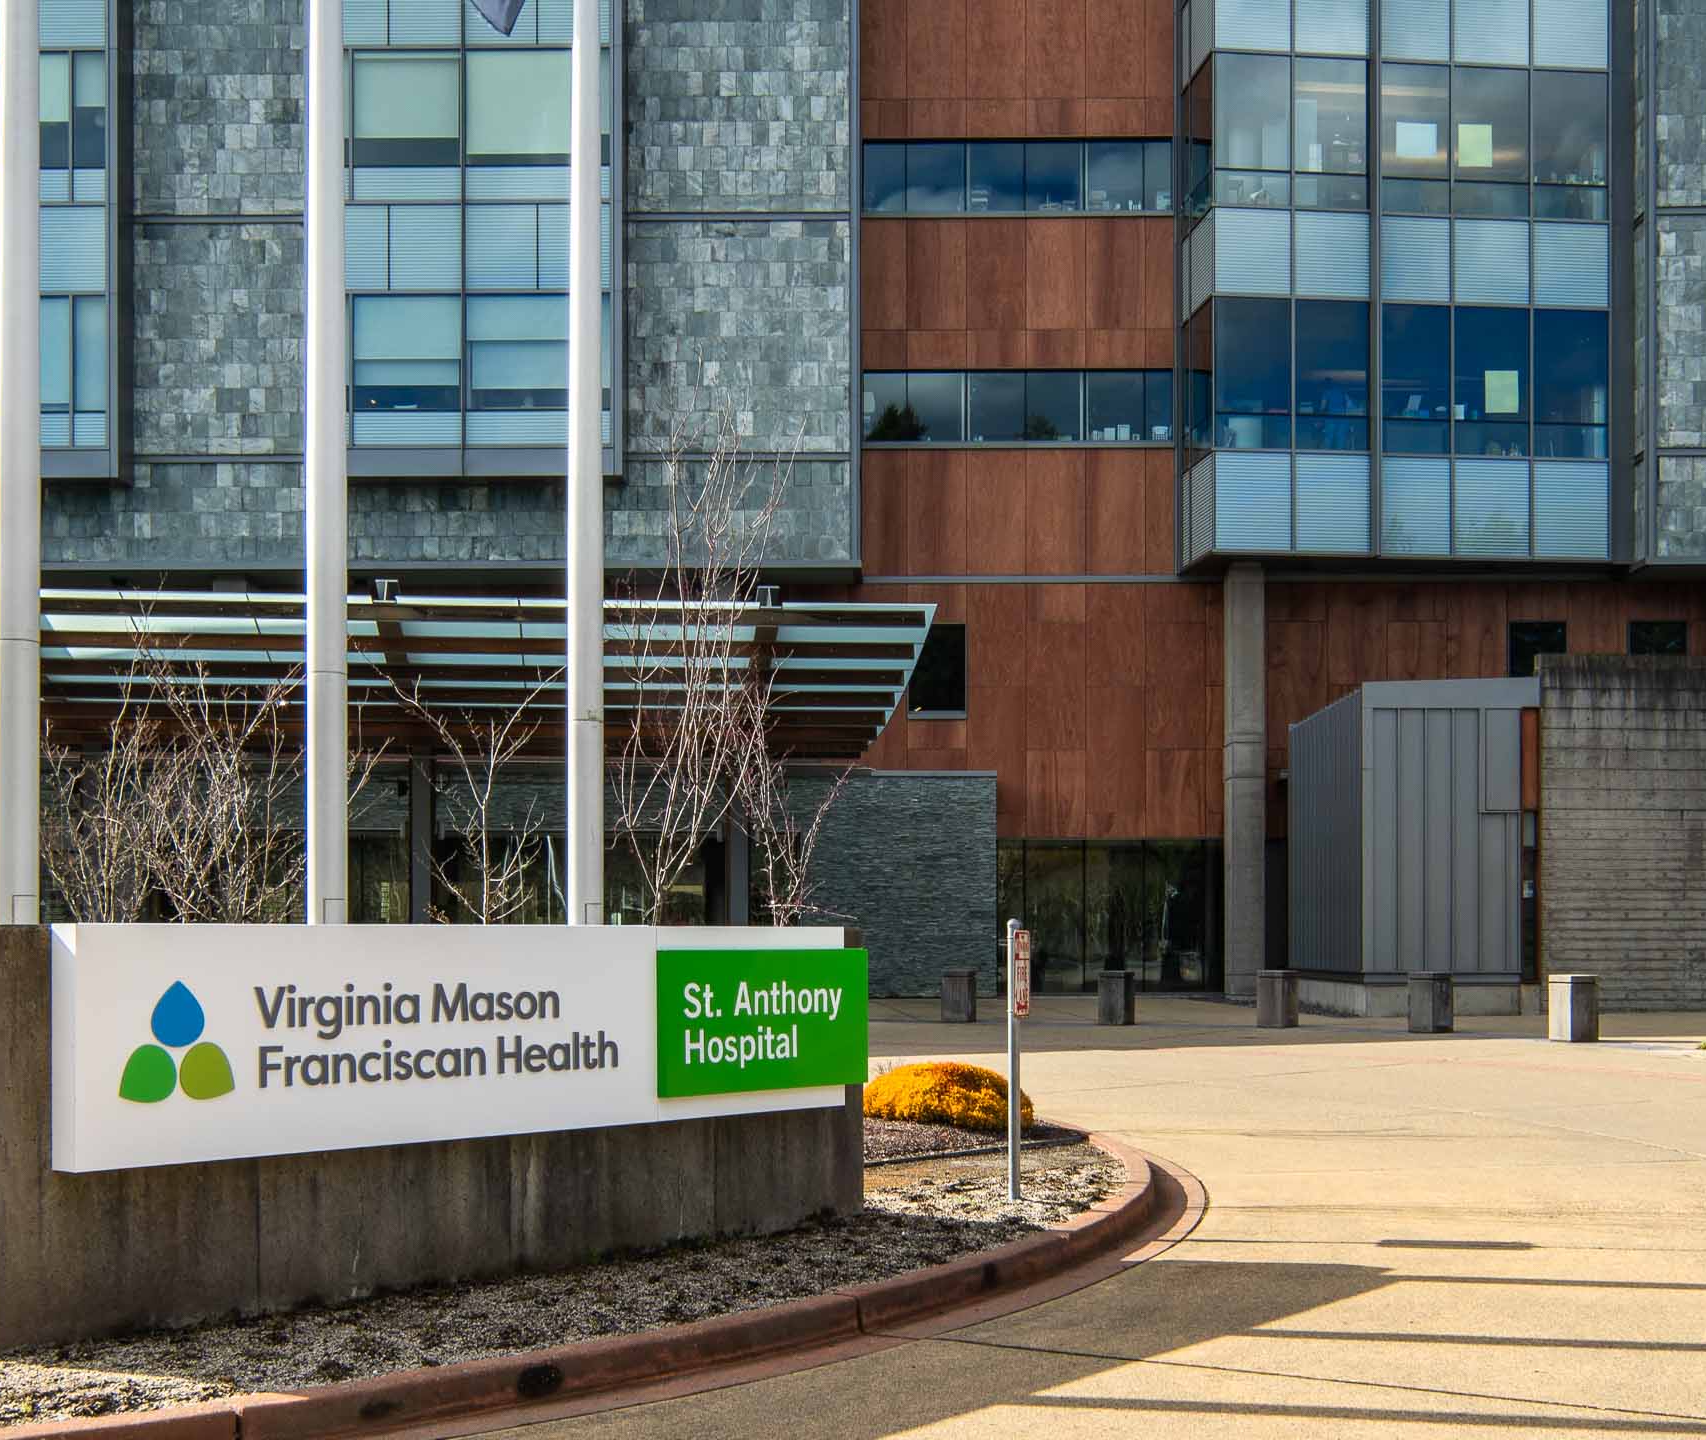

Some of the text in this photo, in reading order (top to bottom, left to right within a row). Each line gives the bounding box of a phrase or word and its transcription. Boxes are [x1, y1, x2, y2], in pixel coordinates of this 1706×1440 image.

[254, 982, 560, 1040] Virginia Mason
[683, 980, 843, 1021] St. Anthony
[258, 1030, 619, 1089] Franciscan Health
[684, 1024, 797, 1069] Hospital
